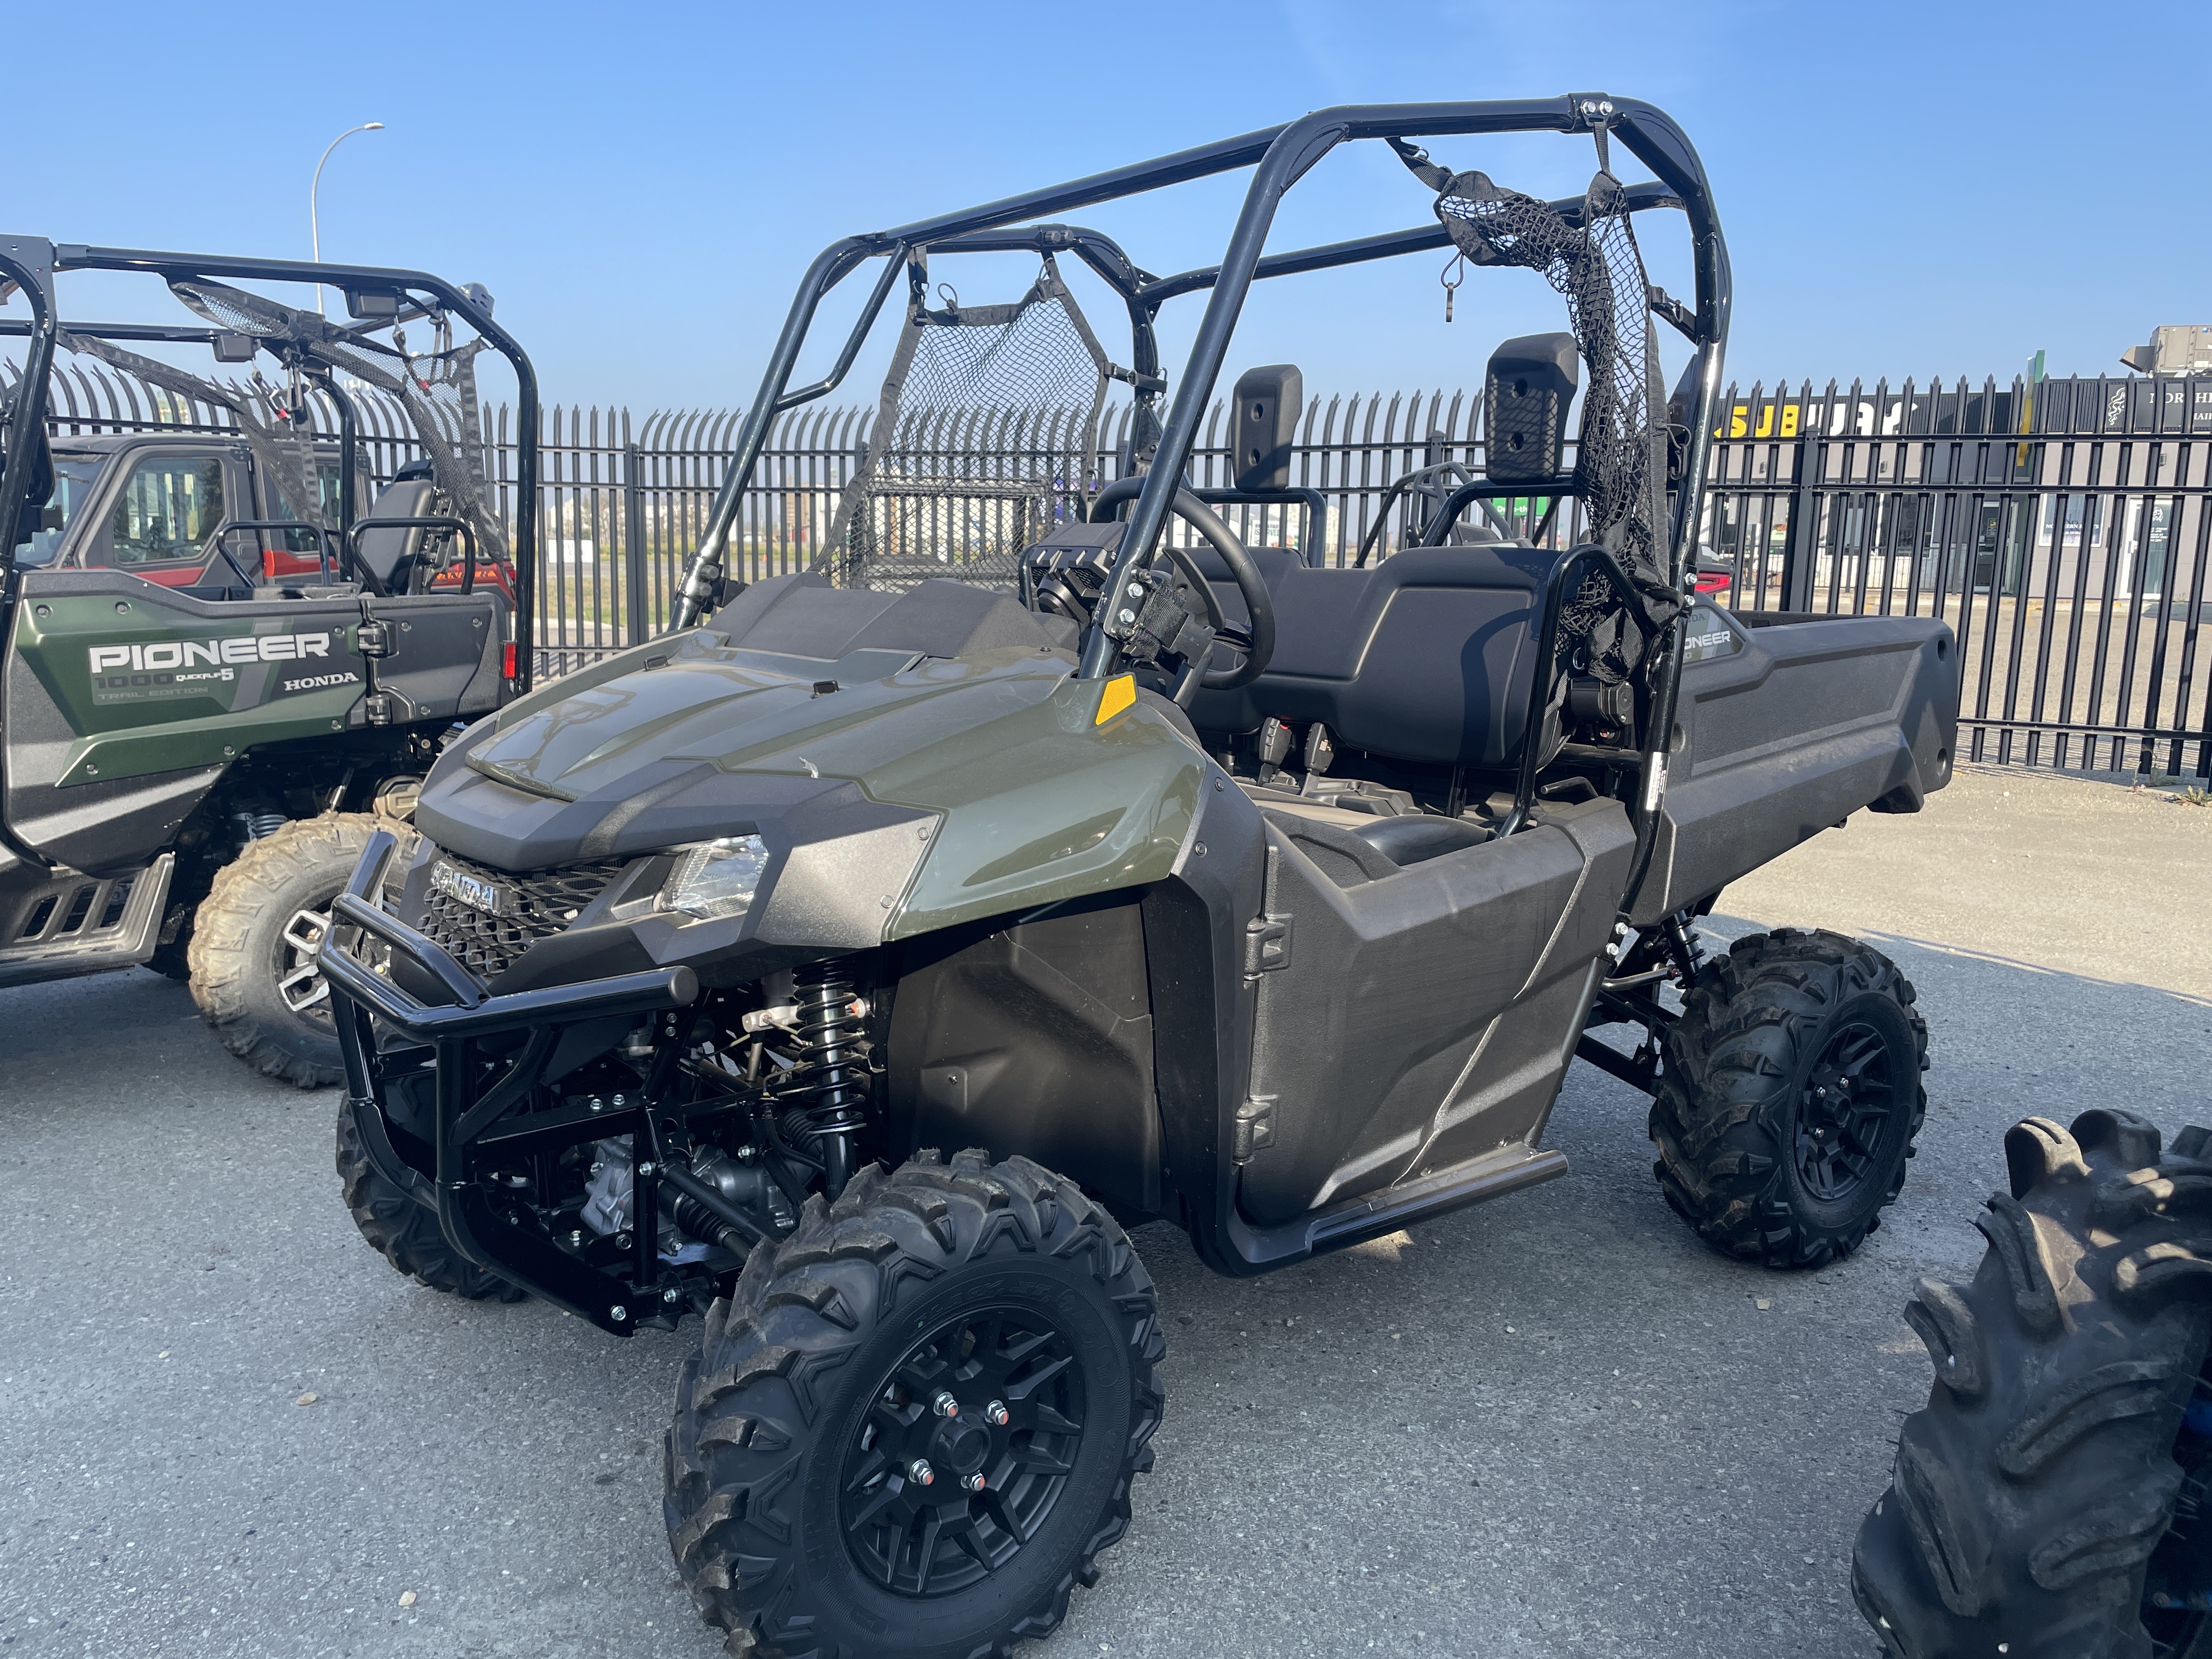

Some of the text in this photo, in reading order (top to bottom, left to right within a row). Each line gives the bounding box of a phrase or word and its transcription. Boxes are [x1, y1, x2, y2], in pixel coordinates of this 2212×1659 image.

[89, 632, 330, 673] PIONEER
[95, 673, 174, 689] 1000
[284, 672, 359, 691] HONDA
[149, 687, 208, 696] EDITION
[430, 860, 500, 917] HONDA
